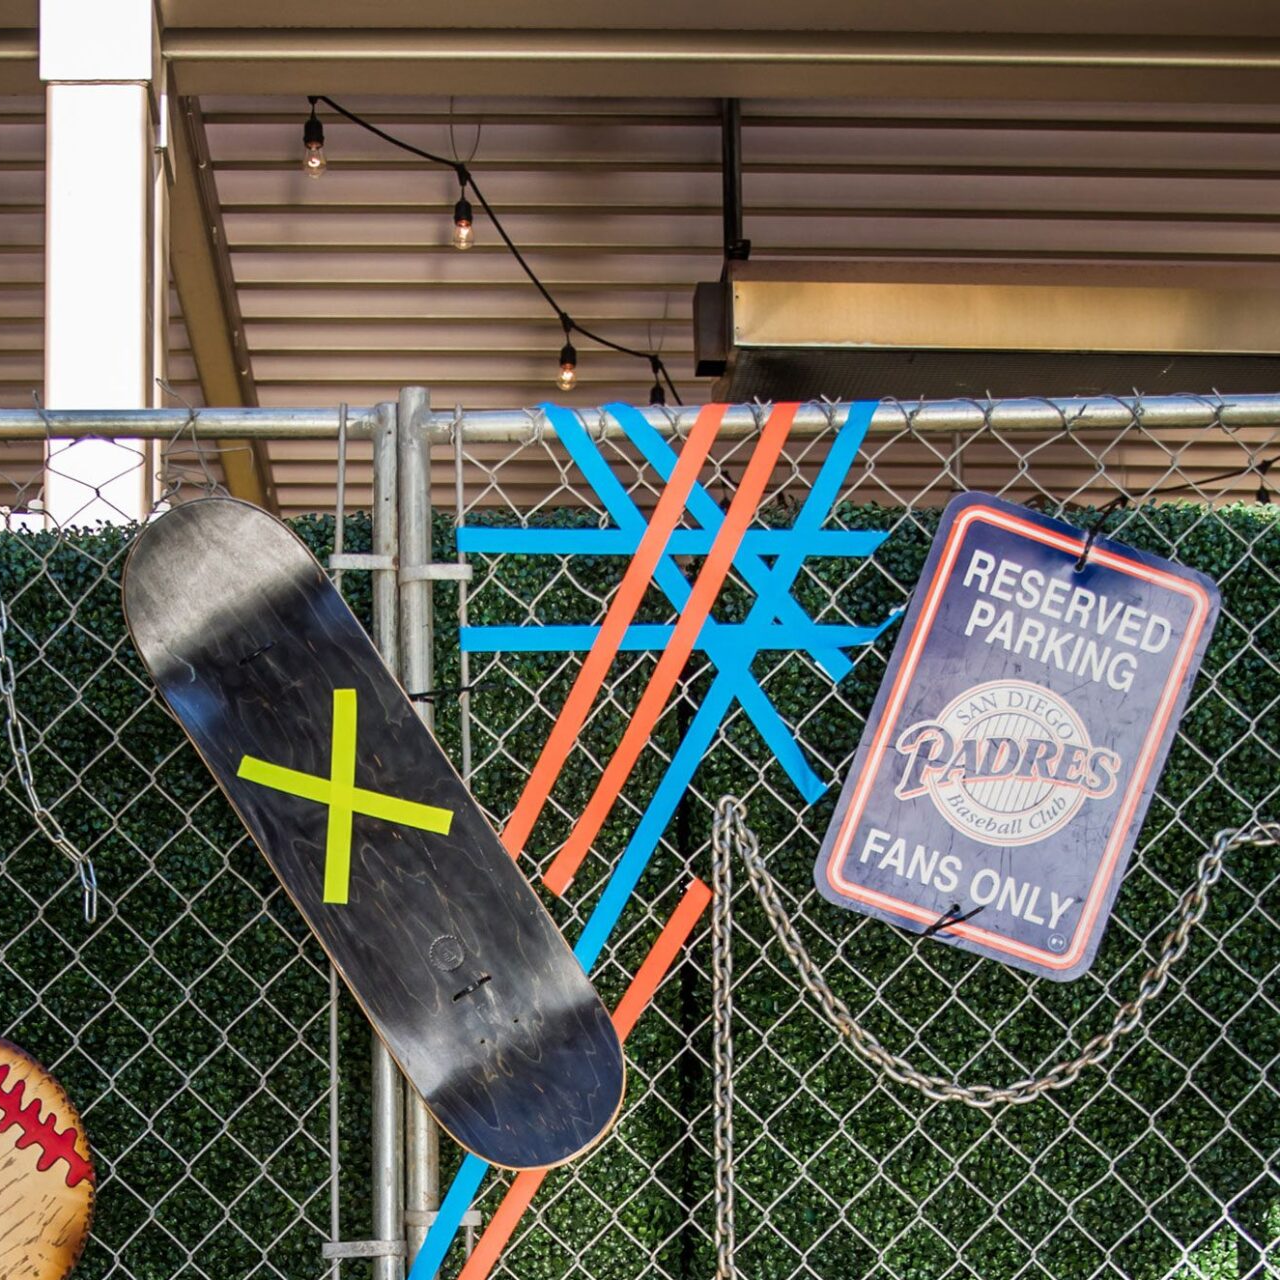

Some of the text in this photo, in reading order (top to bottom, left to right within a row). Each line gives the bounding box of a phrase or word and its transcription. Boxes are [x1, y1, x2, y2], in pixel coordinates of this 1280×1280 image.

[963, 549, 1171, 654] RESERVED
[964, 601, 1138, 693] PARKING
[956, 690, 1074, 741] SAN DIEGO
[895, 721, 1121, 799] PADRES
[947, 793, 1067, 835] Baseball Club
[859, 828, 1075, 930] FANS ONLY
